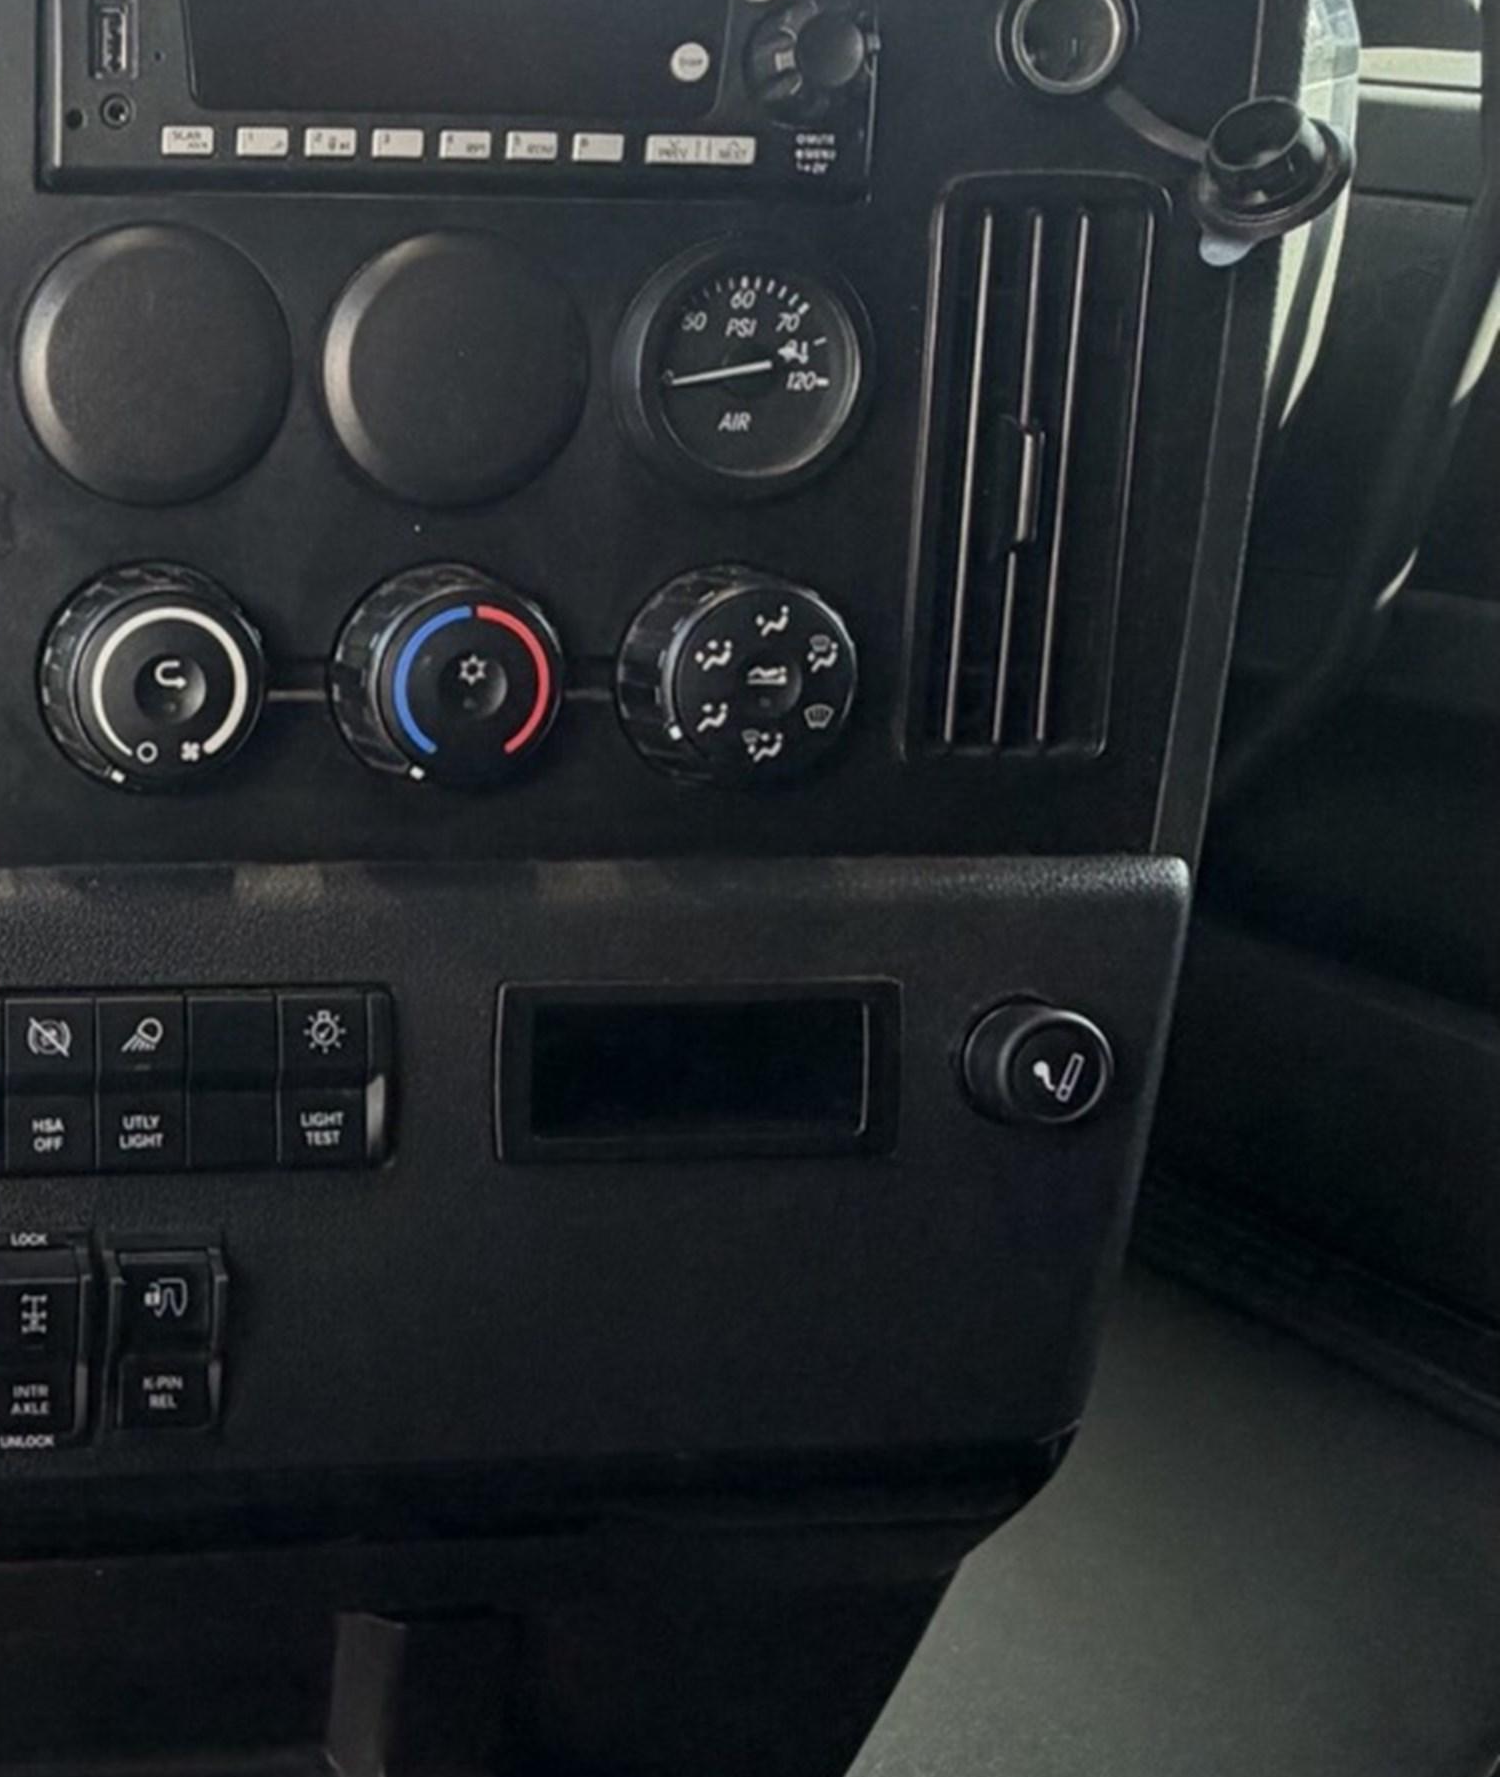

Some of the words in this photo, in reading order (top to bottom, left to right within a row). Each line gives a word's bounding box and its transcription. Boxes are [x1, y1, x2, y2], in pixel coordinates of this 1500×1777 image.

[730, 290, 756, 309] 60
[682, 312, 708, 331] 50
[725, 318, 757, 337] PSI
[776, 313, 800, 332] 70
[786, 370, 816, 391] 120
[718, 412, 751, 432] AIR
[32, 1118, 64, 1133] HSA
[123, 1115, 159, 1130] UTLY
[301, 1112, 343, 1127] LIGHT
[34, 1136, 62, 1152] OFF
[119, 1133, 163, 1149] LIGHT
[306, 1130, 340, 1145] TEST
[11, 1232, 47, 1246] LOCK
[13, 1384, 48, 1397] INTR
[11, 1402, 48, 1415] AXLE
[149, 1394, 176, 1408] REL
[0, 1435, 54, 1448] UNLOCK
